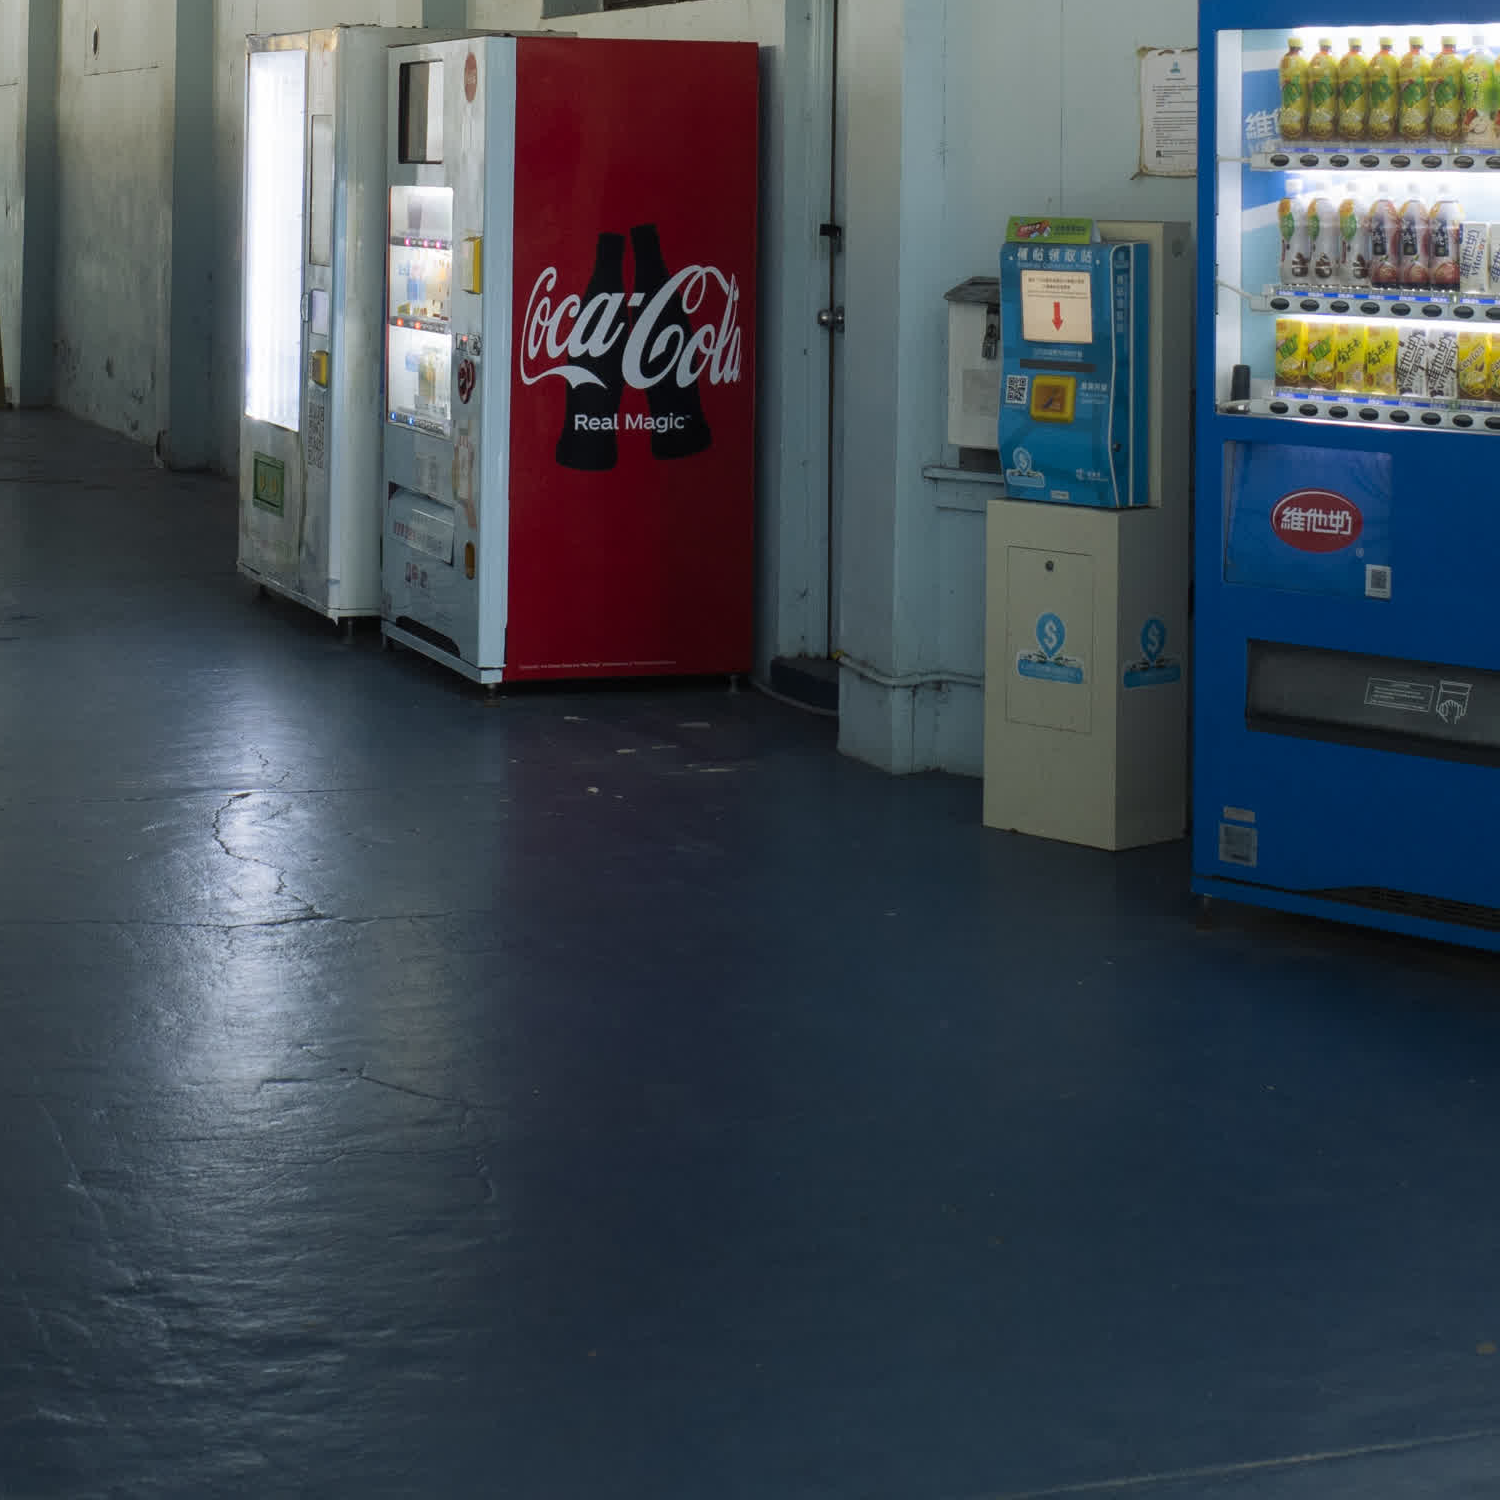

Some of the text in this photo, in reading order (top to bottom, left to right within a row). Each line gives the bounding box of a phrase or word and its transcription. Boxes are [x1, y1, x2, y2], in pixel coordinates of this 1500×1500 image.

[520, 265, 741, 389] Coca-Cola
[574, 412, 685, 433] Real Magic
[1281, 506, 1352, 535] 維他奶
